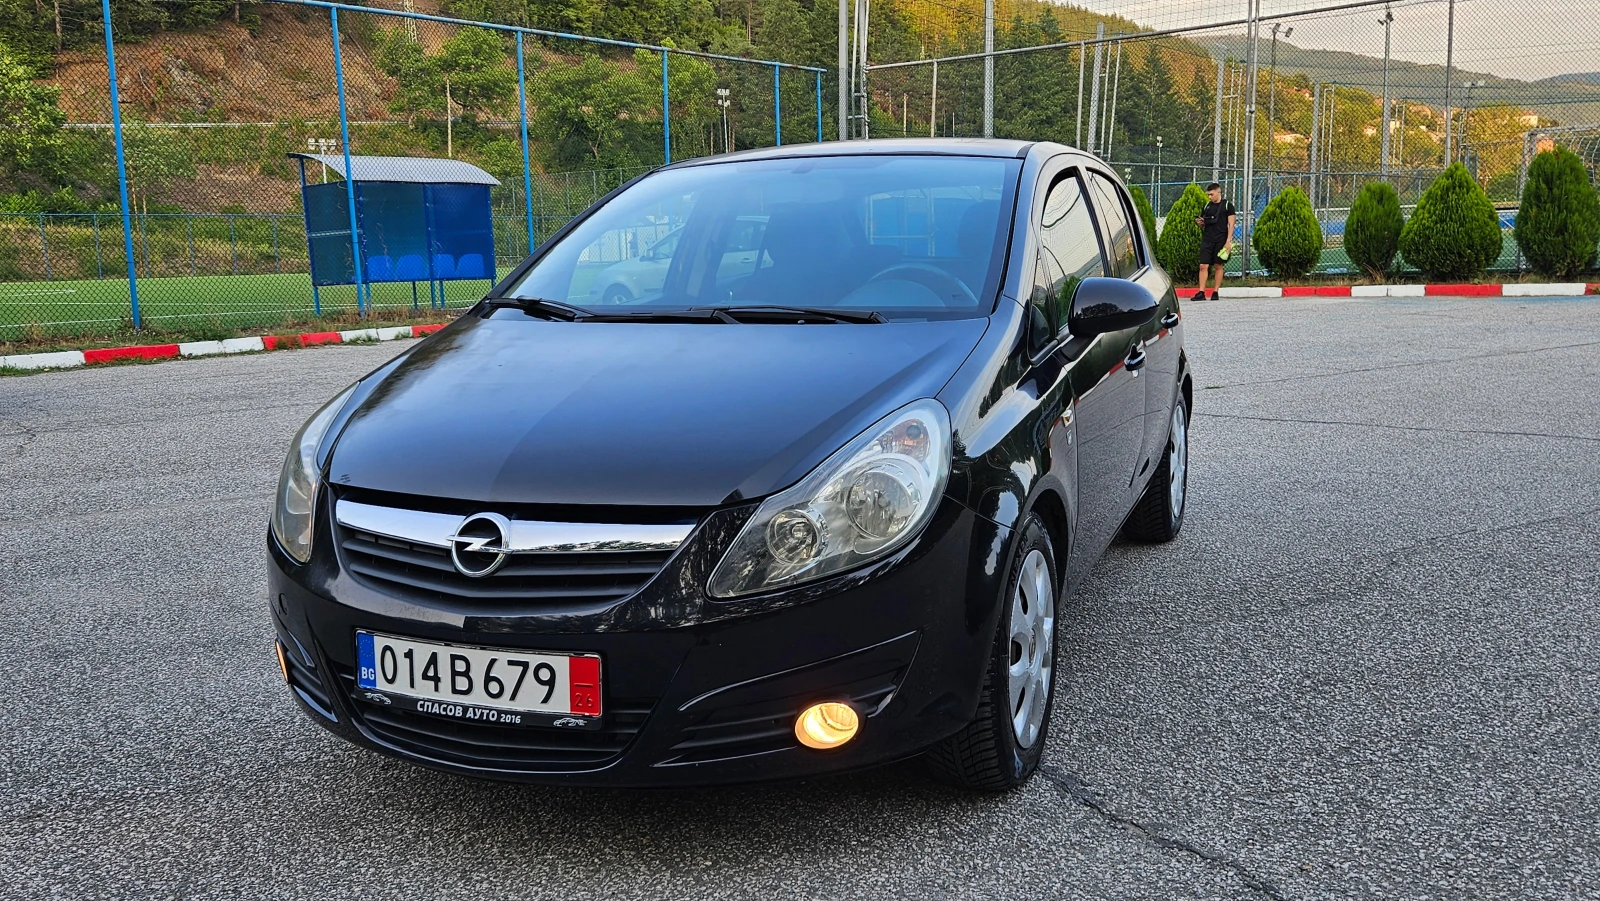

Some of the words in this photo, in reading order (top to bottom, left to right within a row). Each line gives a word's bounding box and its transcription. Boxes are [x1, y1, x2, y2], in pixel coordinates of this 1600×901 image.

[361, 667, 375, 680] BG
[380, 645, 556, 704] 014B679
[574, 692, 593, 708] 26
[416, 700, 463, 717] СПАСОВ
[465, 707, 497, 721] АУТО
[500, 713, 521, 724] 2016
